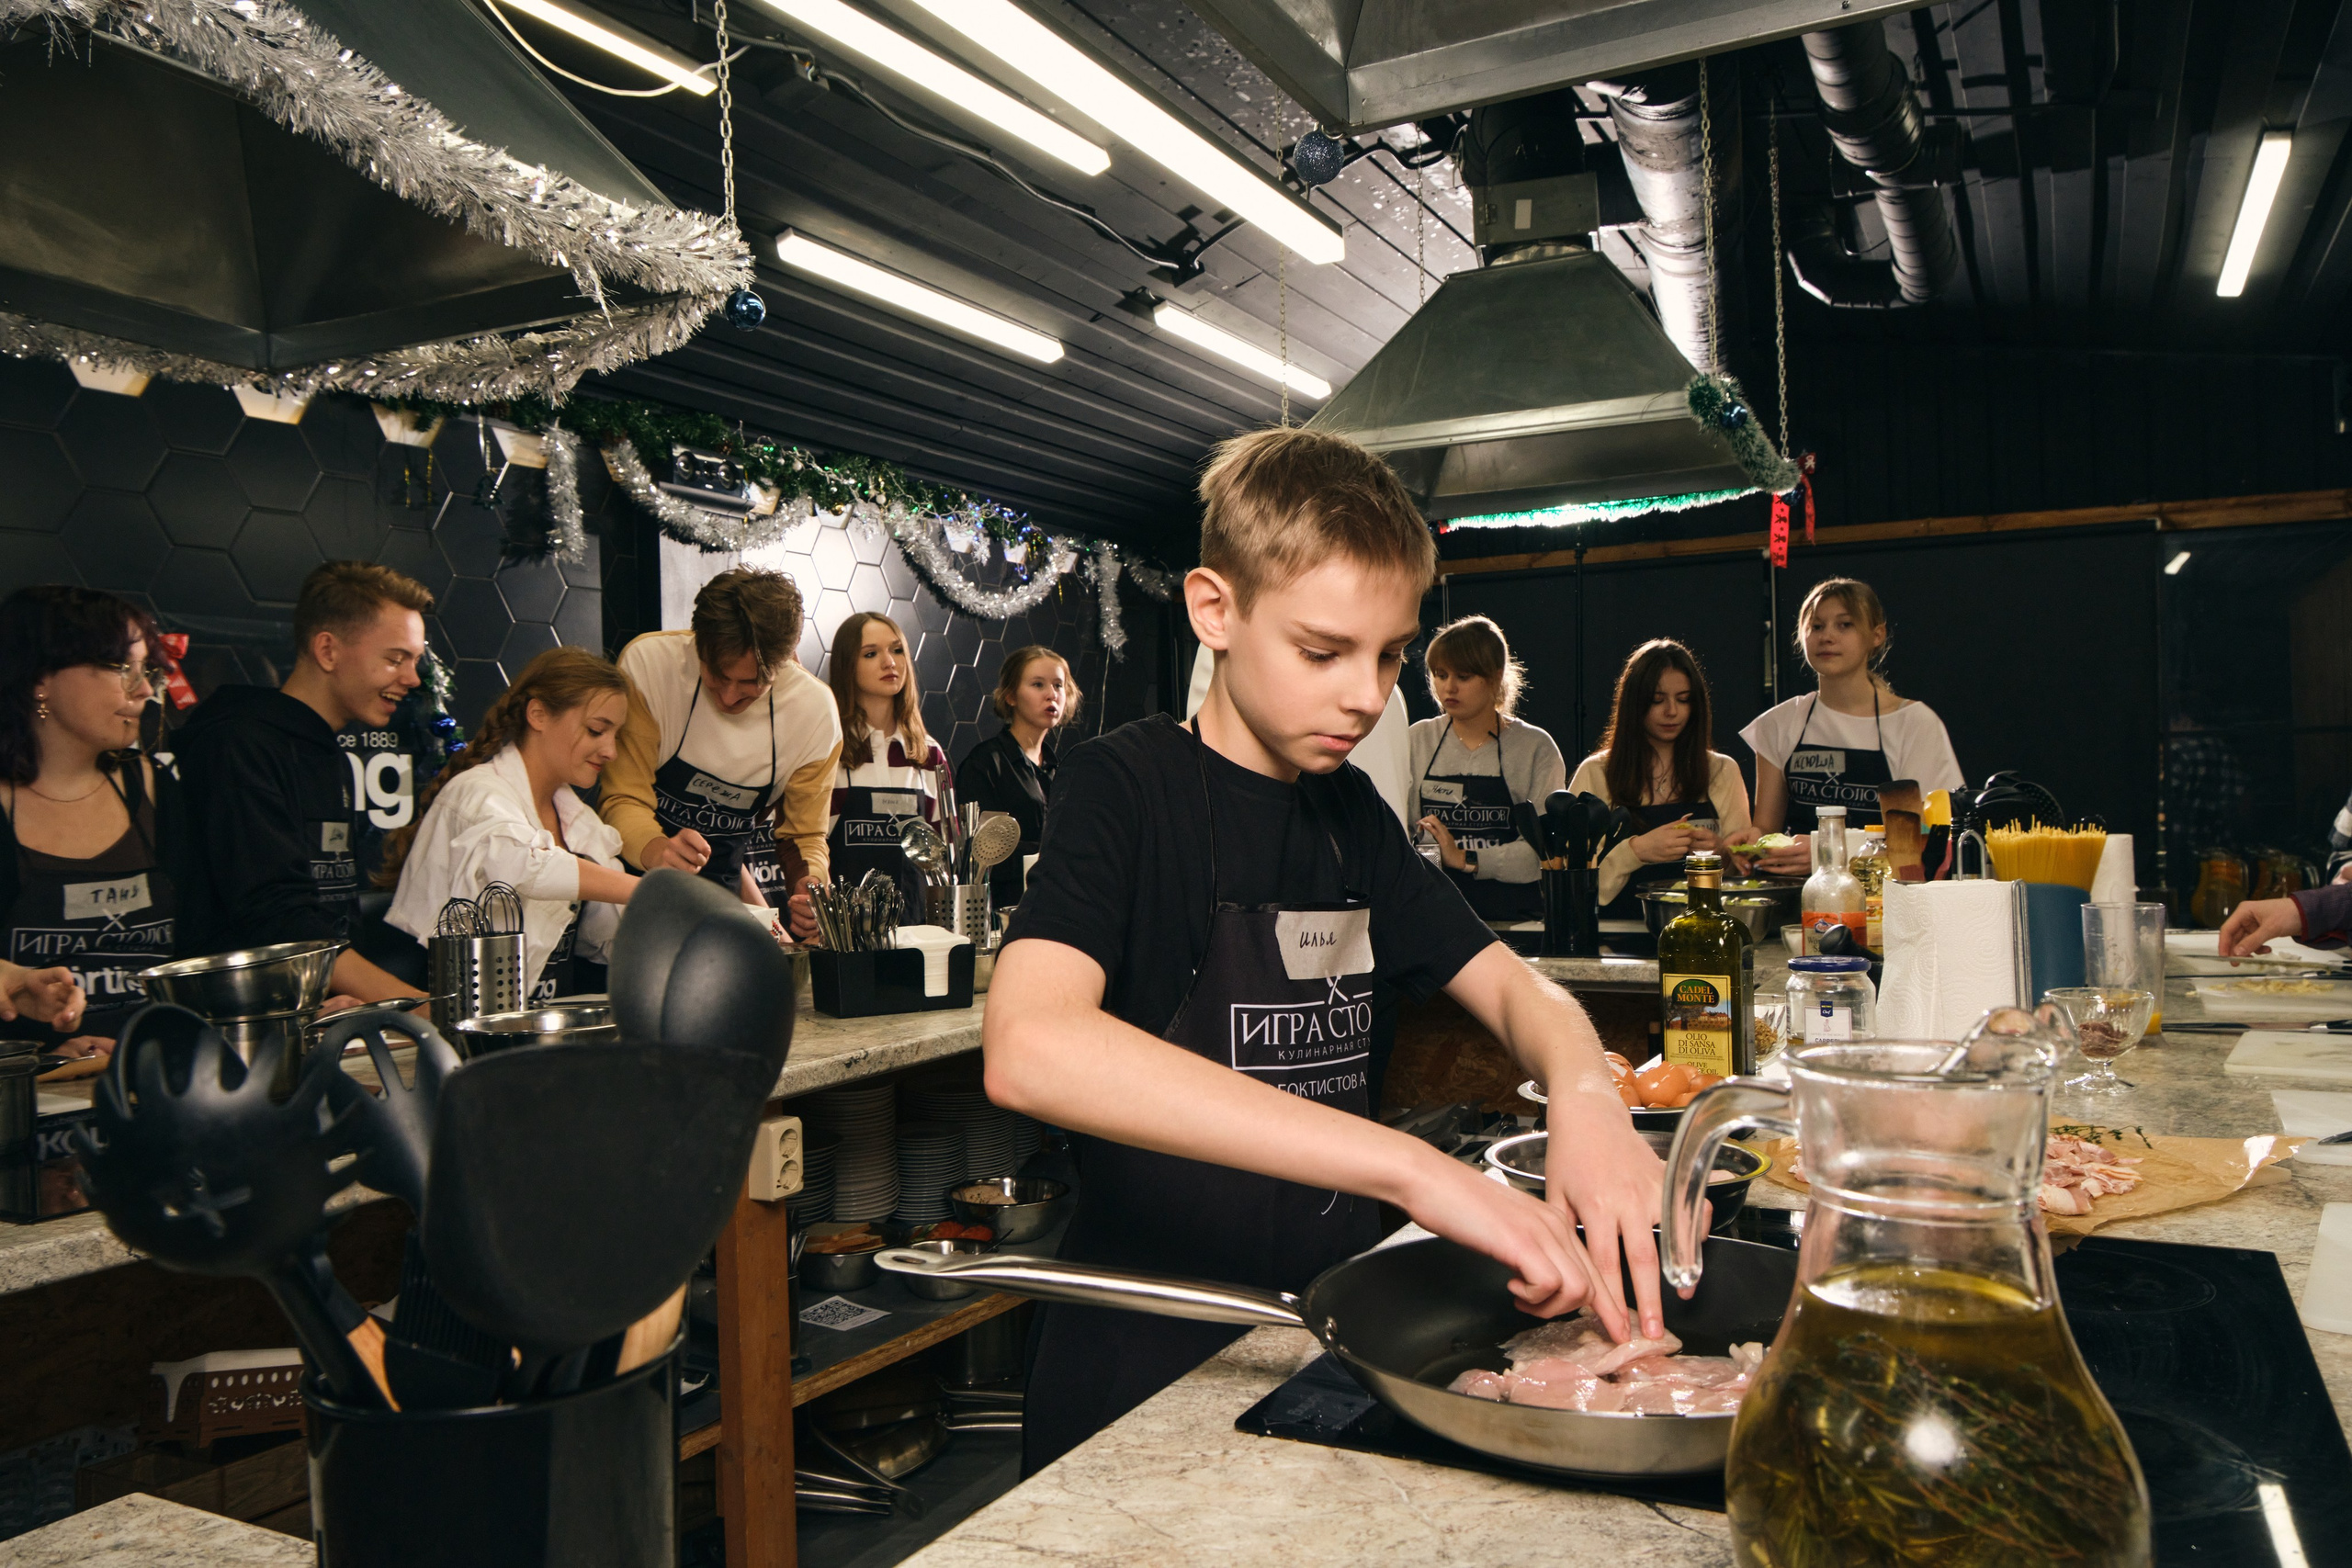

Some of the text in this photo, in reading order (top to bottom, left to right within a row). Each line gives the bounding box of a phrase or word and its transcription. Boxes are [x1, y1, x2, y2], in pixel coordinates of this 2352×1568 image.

[361, 731, 399, 748] 1889
[1821, 784, 1879, 803] СТОЛО
[848, 823, 884, 837] ИГРА
[19, 933, 87, 954] ИГРА
[1679, 985, 1713, 995] CADEL
[1677, 993, 1715, 1003] MONTE
[1240, 1012, 1325, 1045] ИГРА
[1686, 1032, 1708, 1041] OLIO
[1278, 1042, 1355, 1060] КУЛИНАРНАЯ
[1690, 1040, 1715, 1049] SANSA
[1690, 1047, 1716, 1055] OLIVA
[1276, 1071, 1367, 1098] ЕОКТИСТОВА
